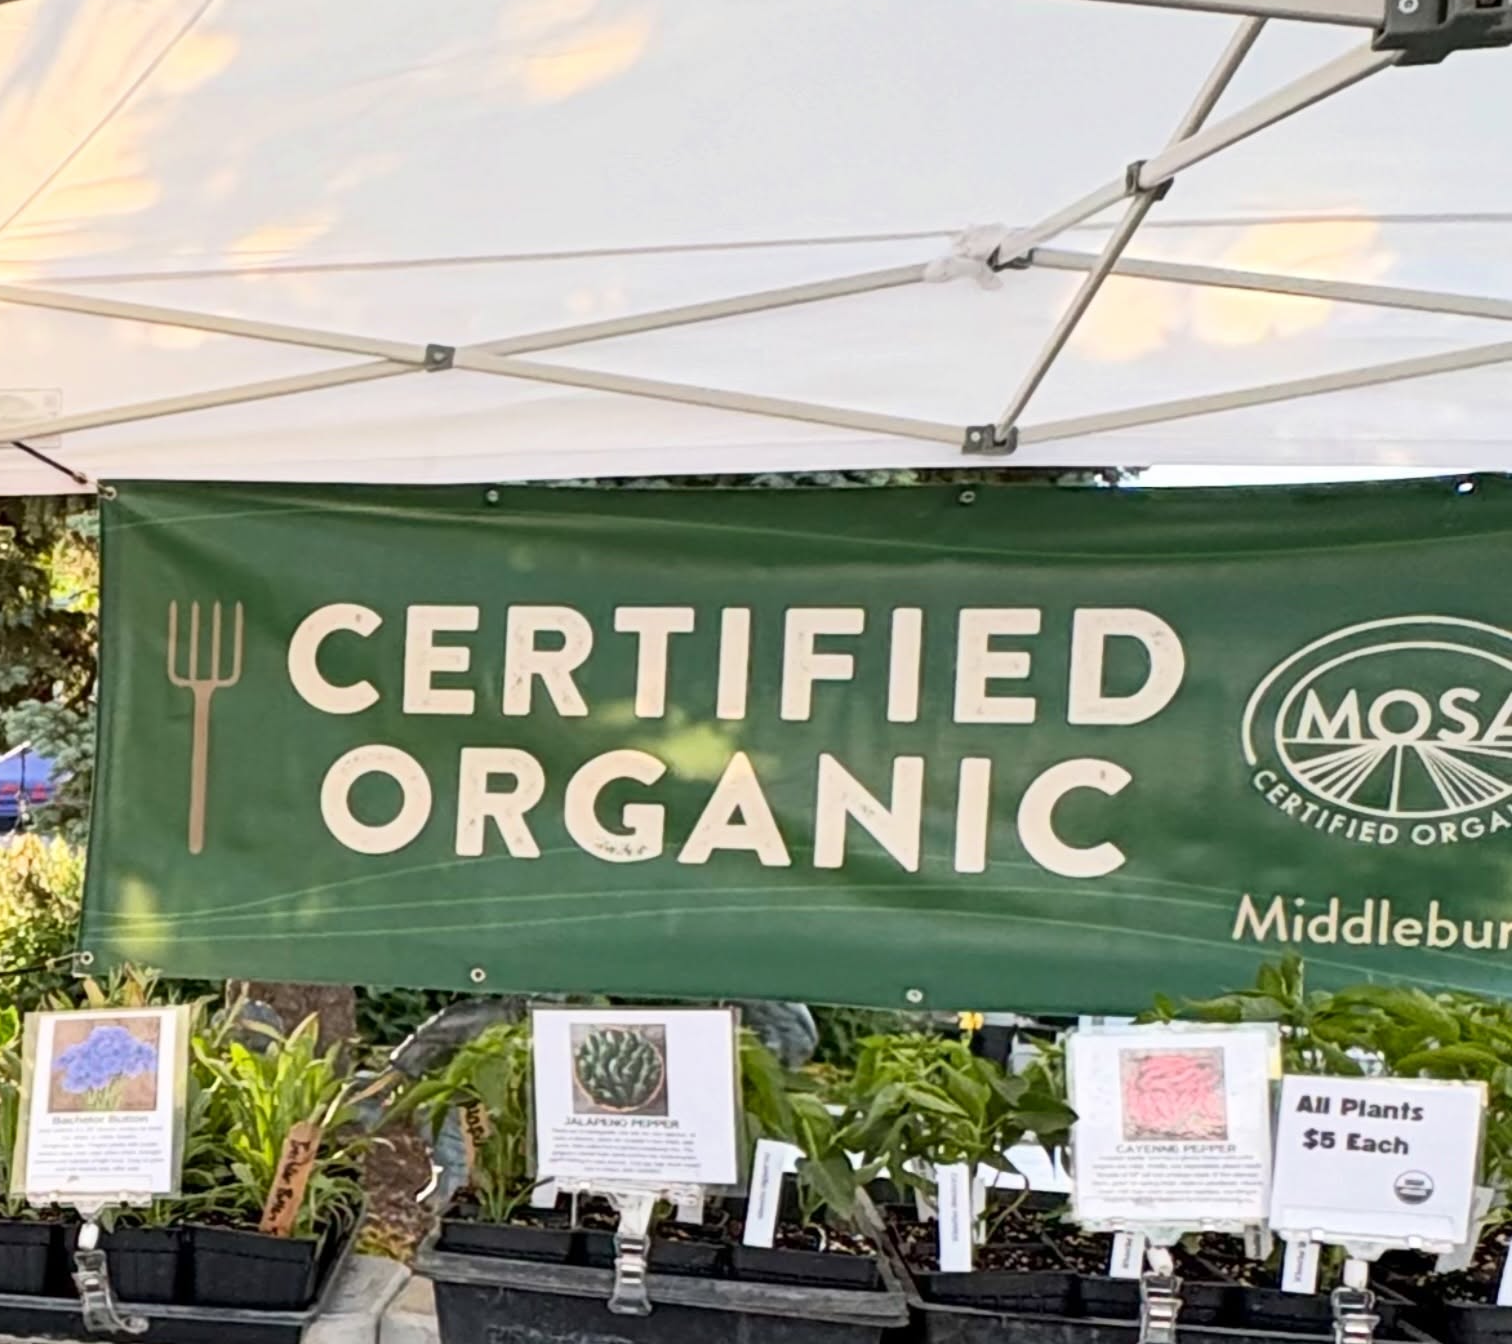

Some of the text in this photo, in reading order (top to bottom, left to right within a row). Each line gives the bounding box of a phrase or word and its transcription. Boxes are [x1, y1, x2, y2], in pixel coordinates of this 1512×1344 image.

[288, 603, 1185, 725] CERTIFIED
[321, 744, 1132, 878] ORGANIC
[1253, 769, 1512, 846] CERTIFIED ORGA
[1296, 1095, 1424, 1121] All Plants
[1302, 1128, 1409, 1155] $5 Each
